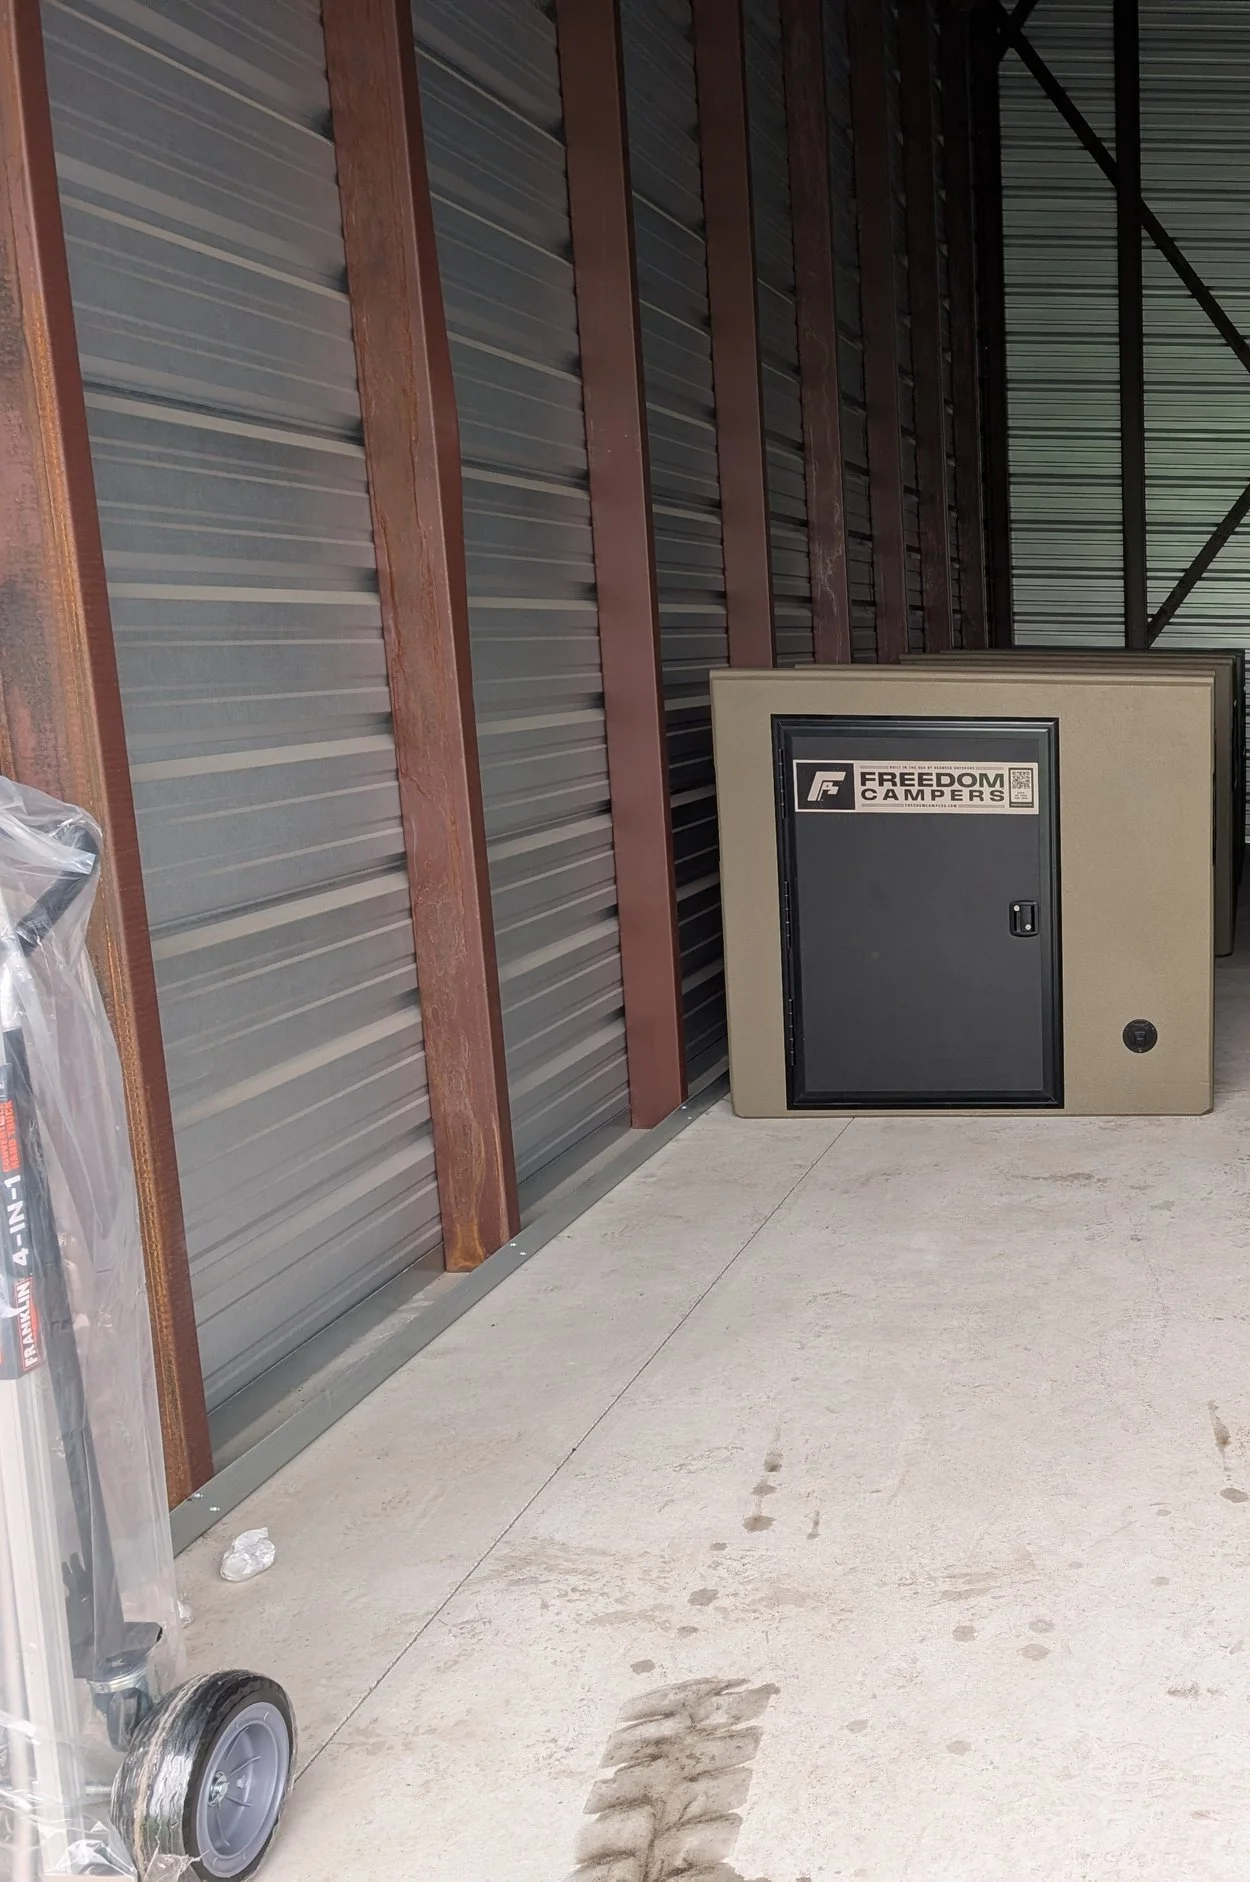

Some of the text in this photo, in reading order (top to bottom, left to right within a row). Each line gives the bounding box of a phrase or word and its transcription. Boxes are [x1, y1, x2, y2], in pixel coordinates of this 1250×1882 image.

[860, 771, 1004, 788] FREEDOM
[860, 788, 1005, 802] CAMPERS
[5, 1099, 20, 1169] HAND TRUCK
[4, 1174, 29, 1267] 4-IN-1
[16, 1280, 38, 1368] FRANKLIN
